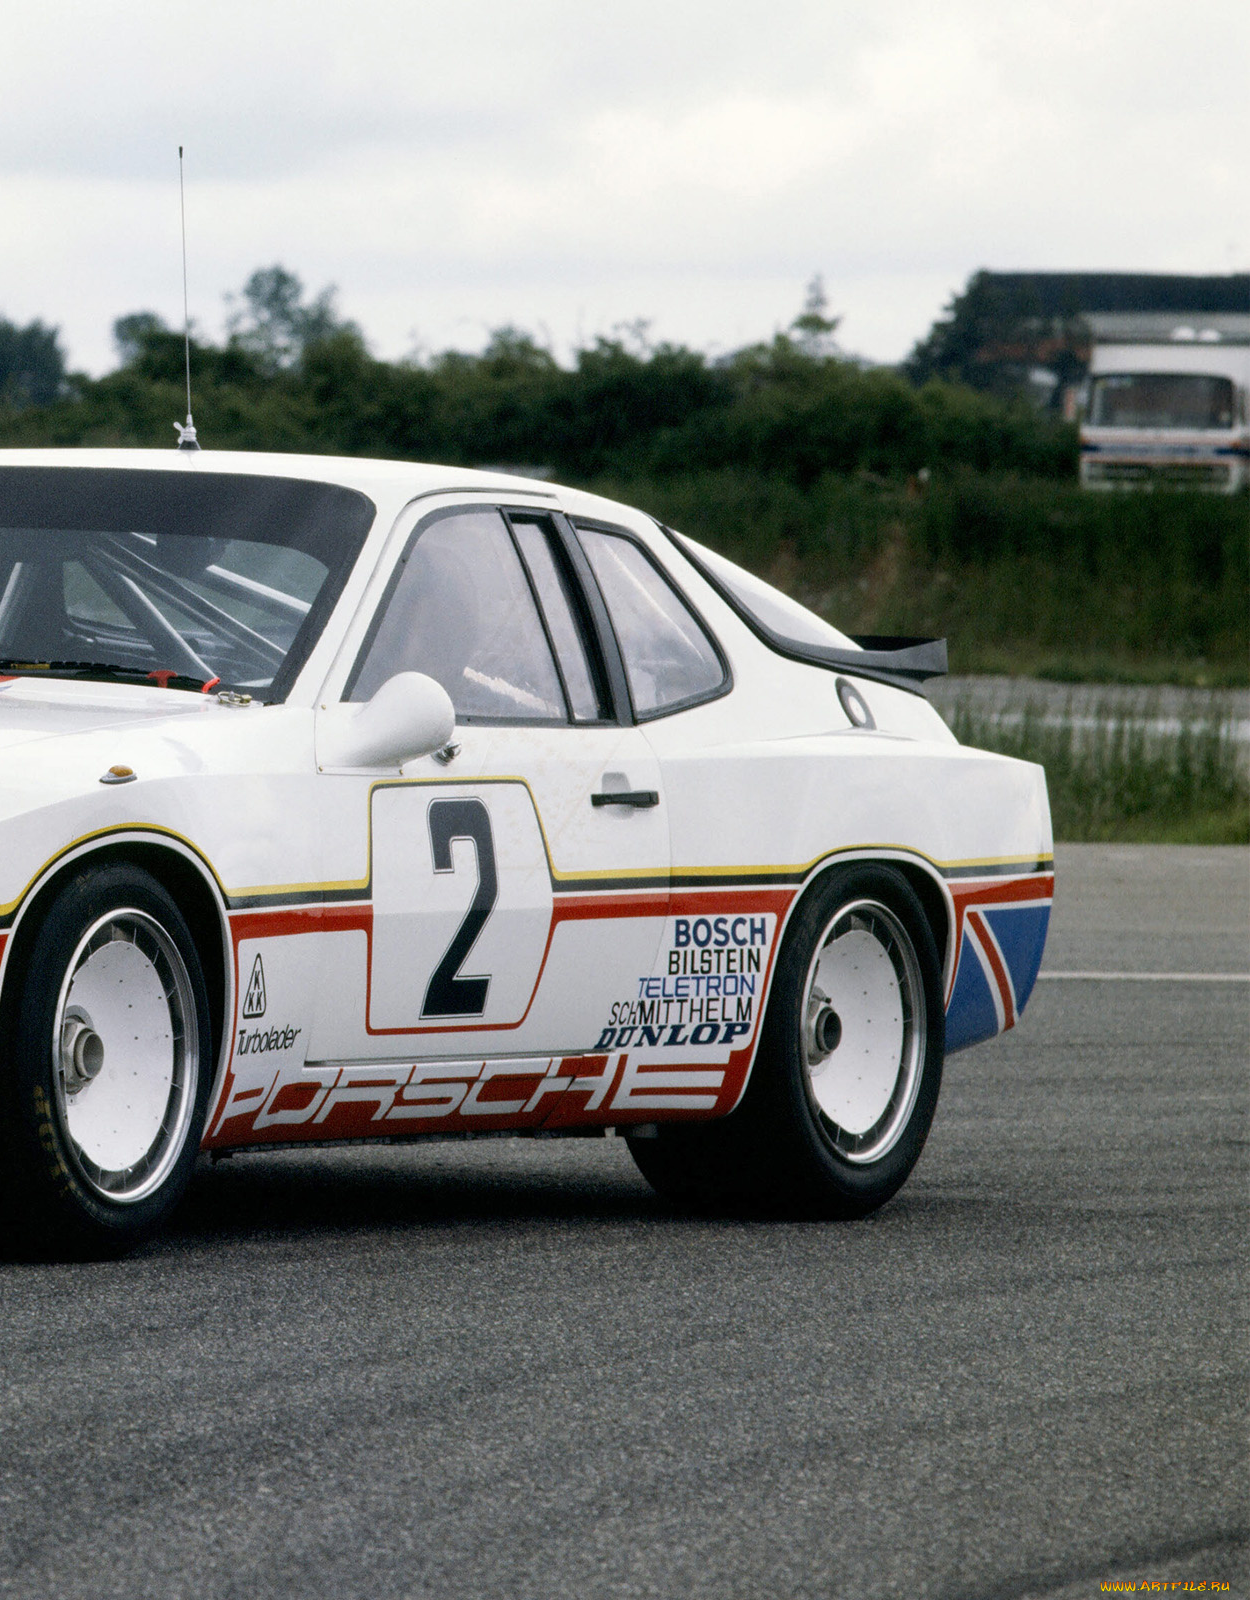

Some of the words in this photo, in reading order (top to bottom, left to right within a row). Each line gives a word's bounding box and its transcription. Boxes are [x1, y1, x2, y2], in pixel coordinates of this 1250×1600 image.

[418, 796, 499, 1019] 2
[674, 917, 766, 948] BOSCH
[668, 948, 761, 975] BILSTEIN
[639, 974, 756, 998] TELETRON
[608, 997, 753, 1026] SCHMITTHELM
[237, 1023, 302, 1055] Turbolader
[593, 1022, 752, 1049] DUNLOP
[212, 1049, 732, 1137] PORSCHE
